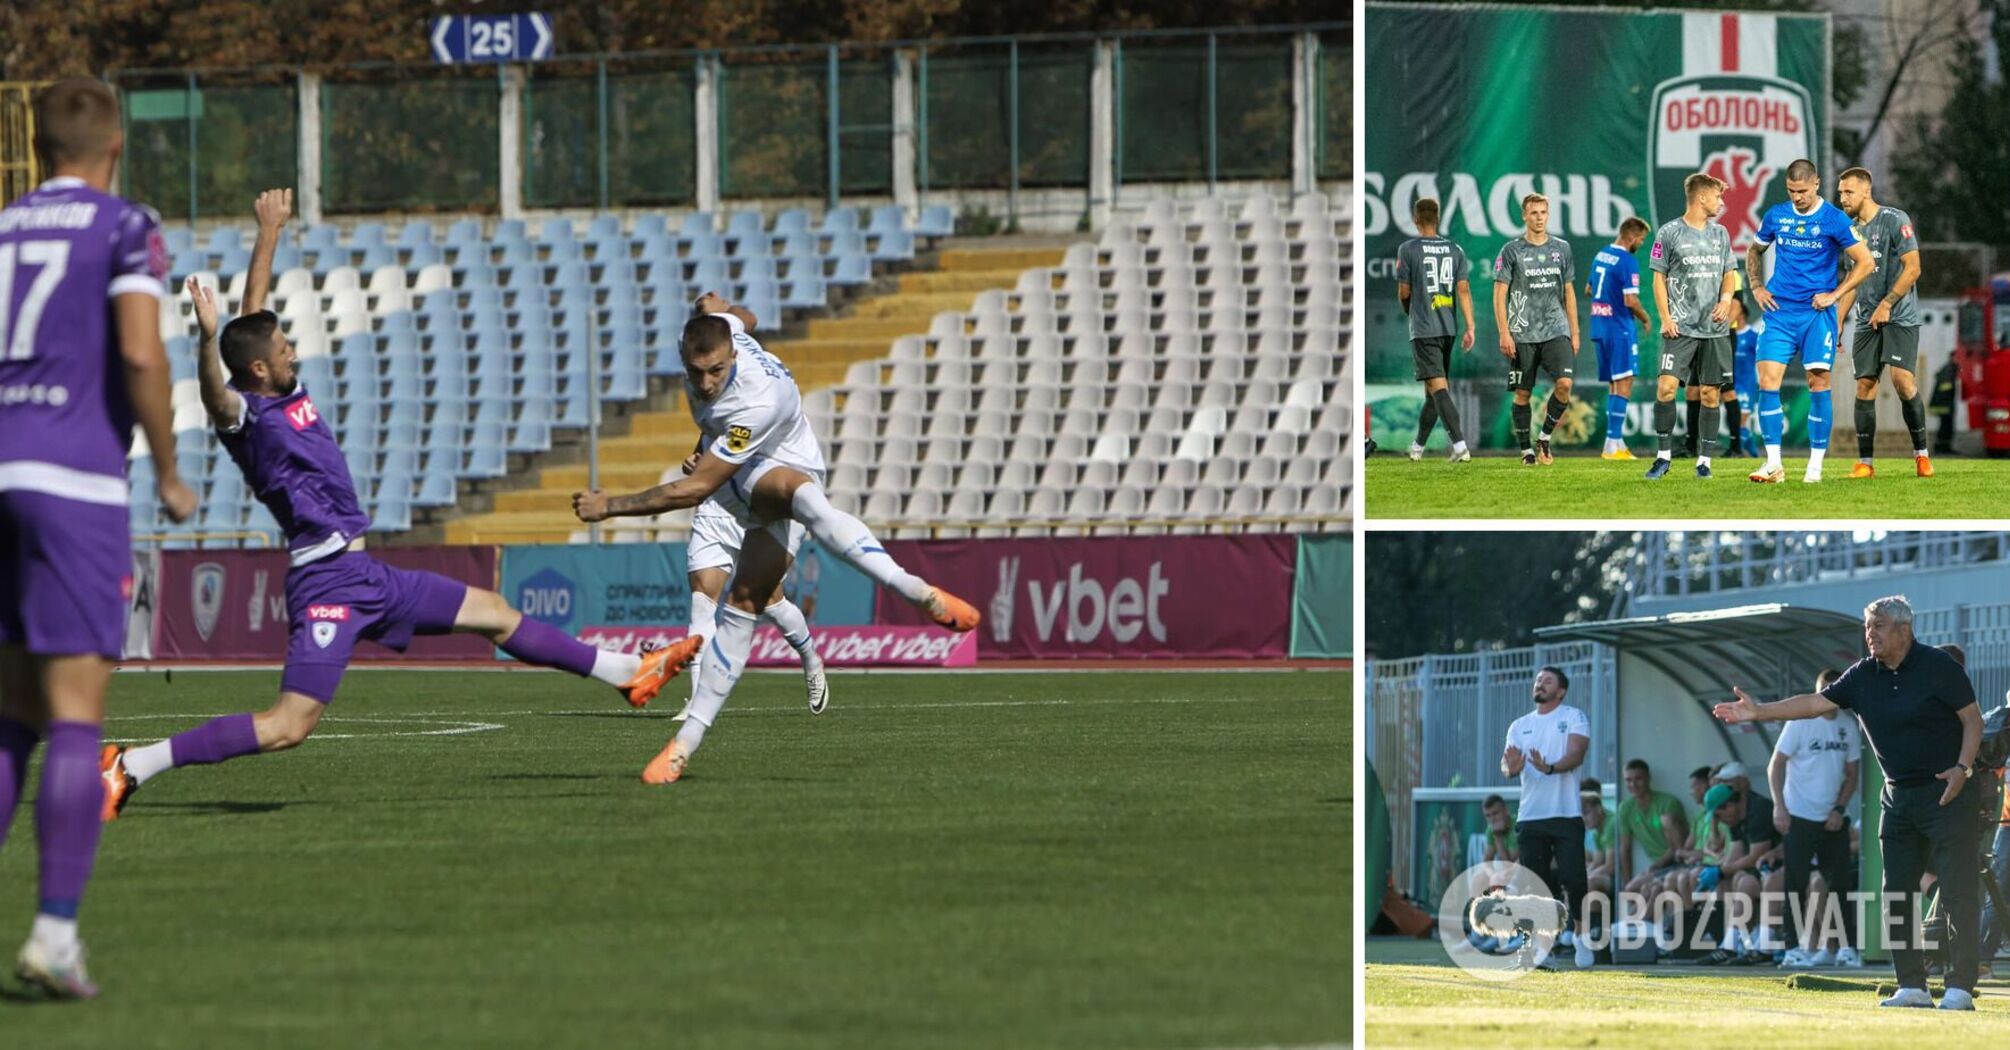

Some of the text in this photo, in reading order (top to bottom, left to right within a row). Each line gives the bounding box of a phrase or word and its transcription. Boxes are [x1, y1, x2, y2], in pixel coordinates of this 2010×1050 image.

[471, 21, 512, 55] 25
[1666, 97, 1799, 134] ОБОЛОНЬ
[1423, 256, 1453, 293] 34
[1595, 265, 1606, 299] 7
[0, 240, 71, 361] 17
[1824, 331, 1833, 351] 4
[1661, 353, 1675, 371] 16
[1508, 370, 1523, 385] 37
[310, 606, 346, 620] vbet
[522, 587, 571, 616] DIVO
[605, 607, 626, 622] ДО
[1027, 561, 1169, 643] vbet
[824, 631, 892, 661] vbet
[891, 632, 962, 661] vbet
